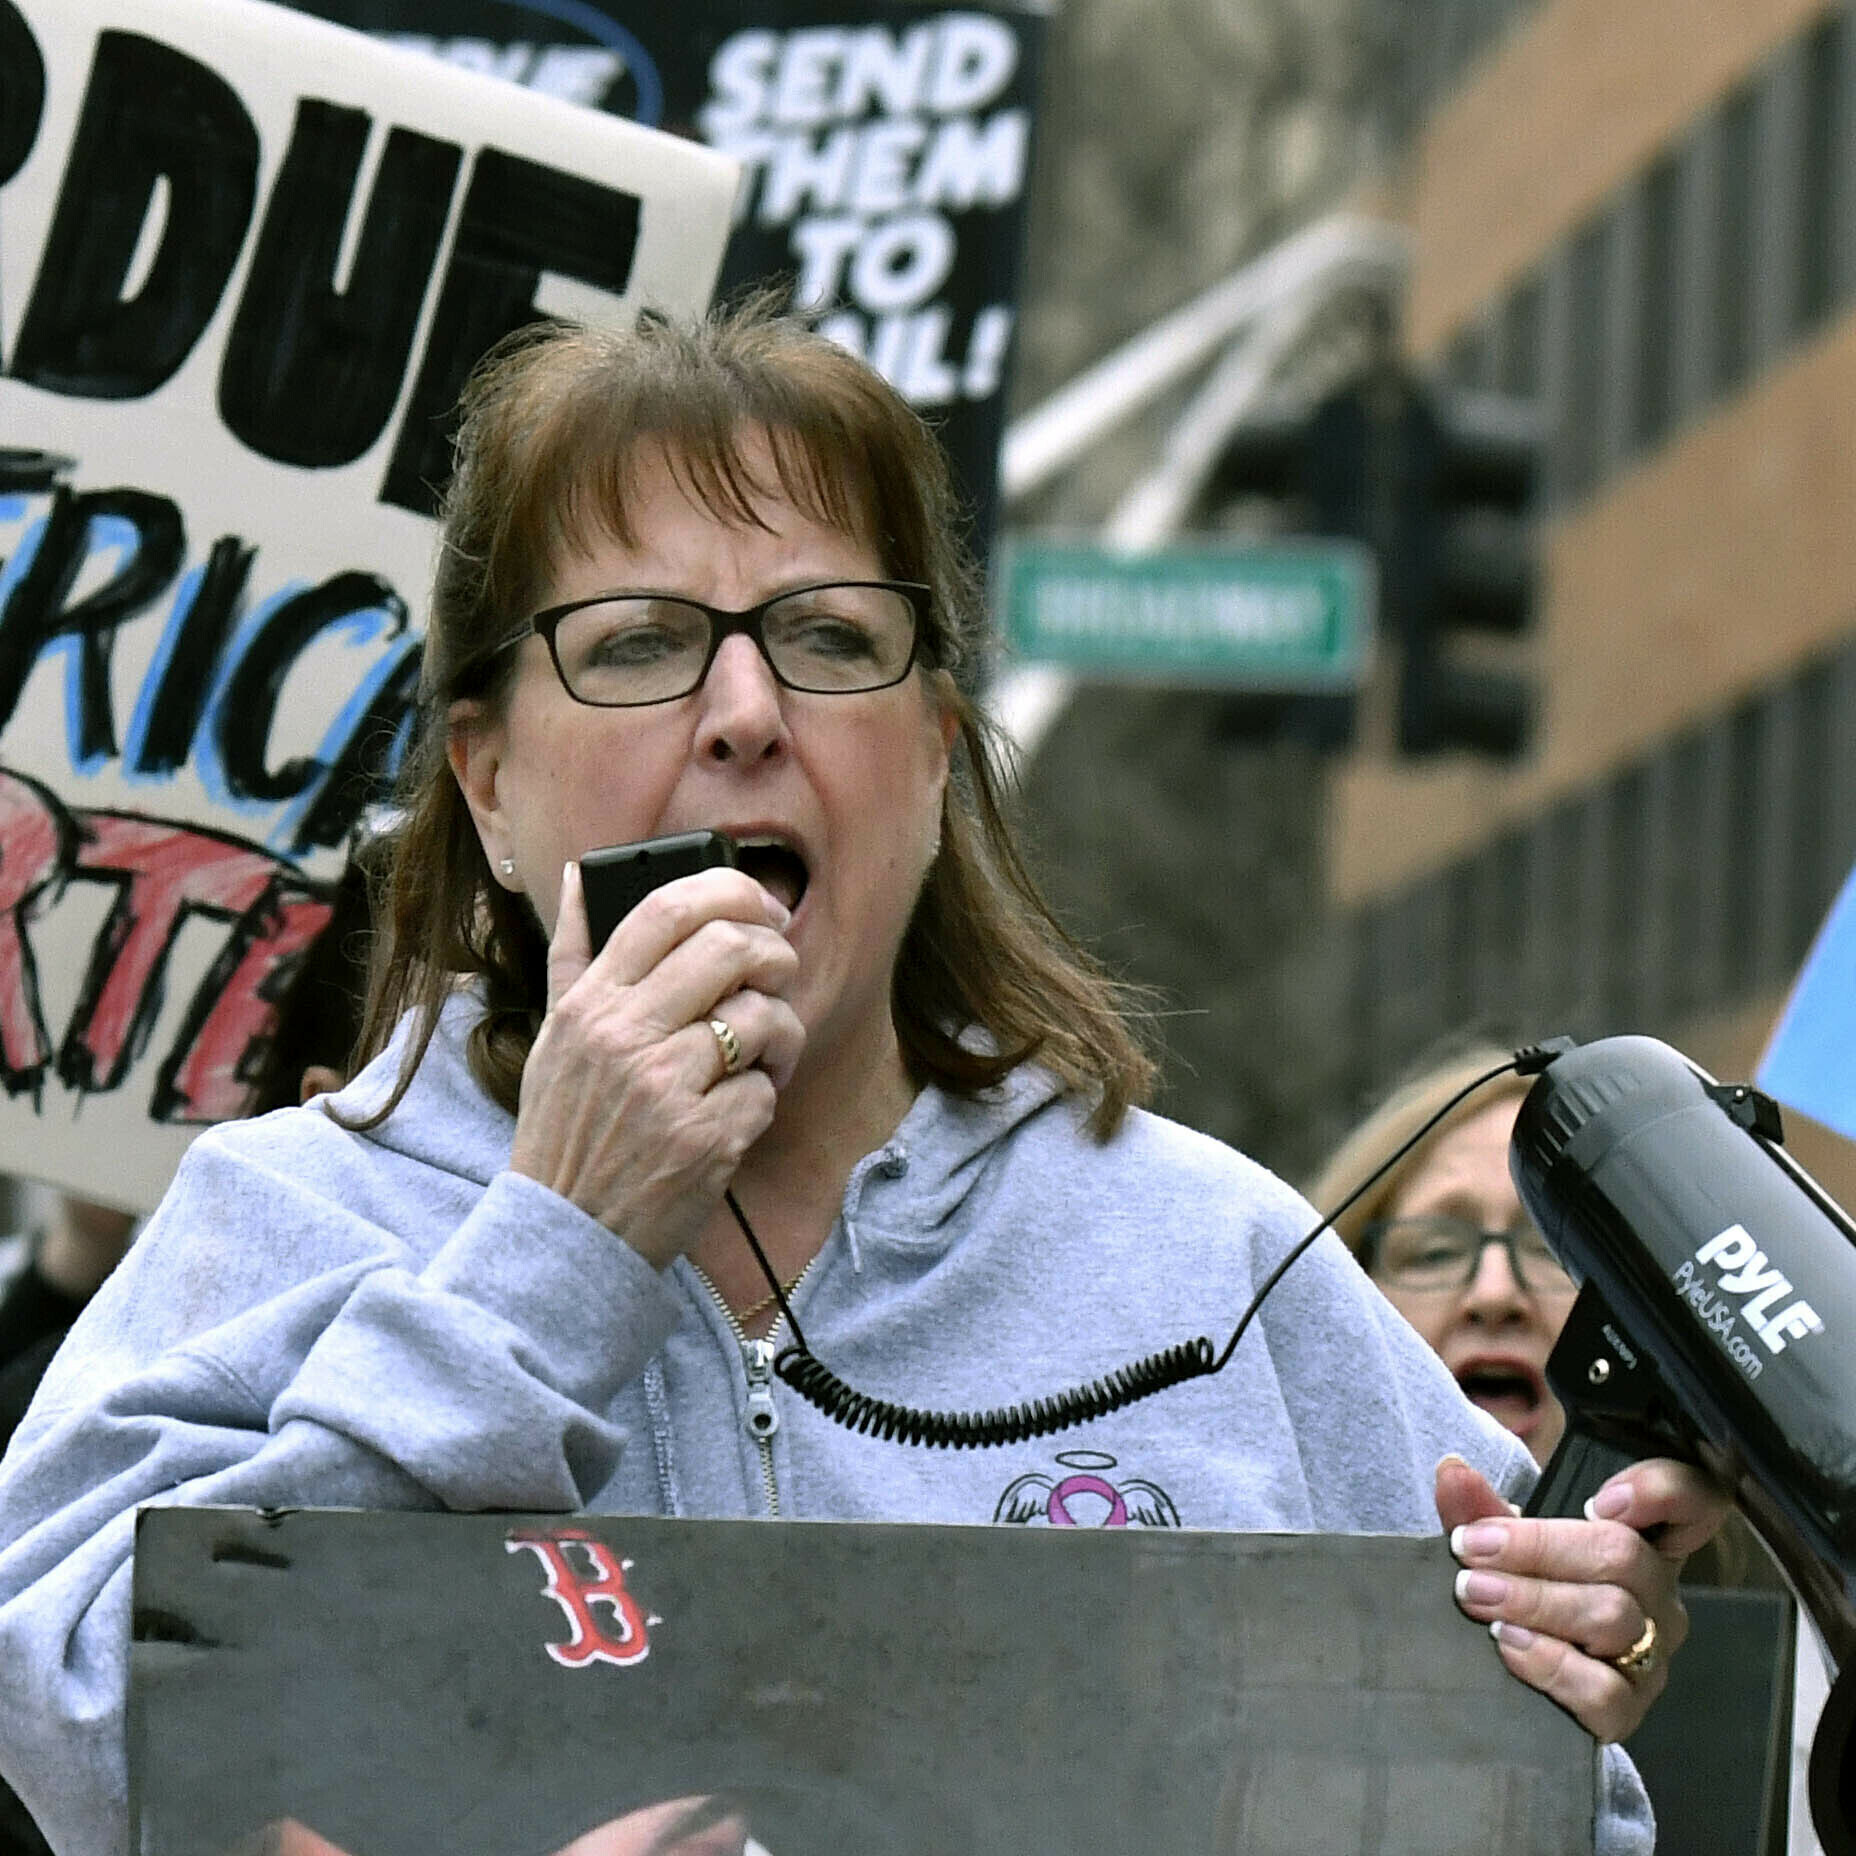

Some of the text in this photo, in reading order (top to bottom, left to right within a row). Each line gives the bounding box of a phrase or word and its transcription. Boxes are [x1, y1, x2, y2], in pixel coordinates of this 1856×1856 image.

[707, 12, 1022, 125] SEND
[701, 108, 1031, 224] THEM
[791, 213, 957, 310] TO
[1695, 1223, 1823, 1355] PYLE
[506, 1528, 662, 1668] B
